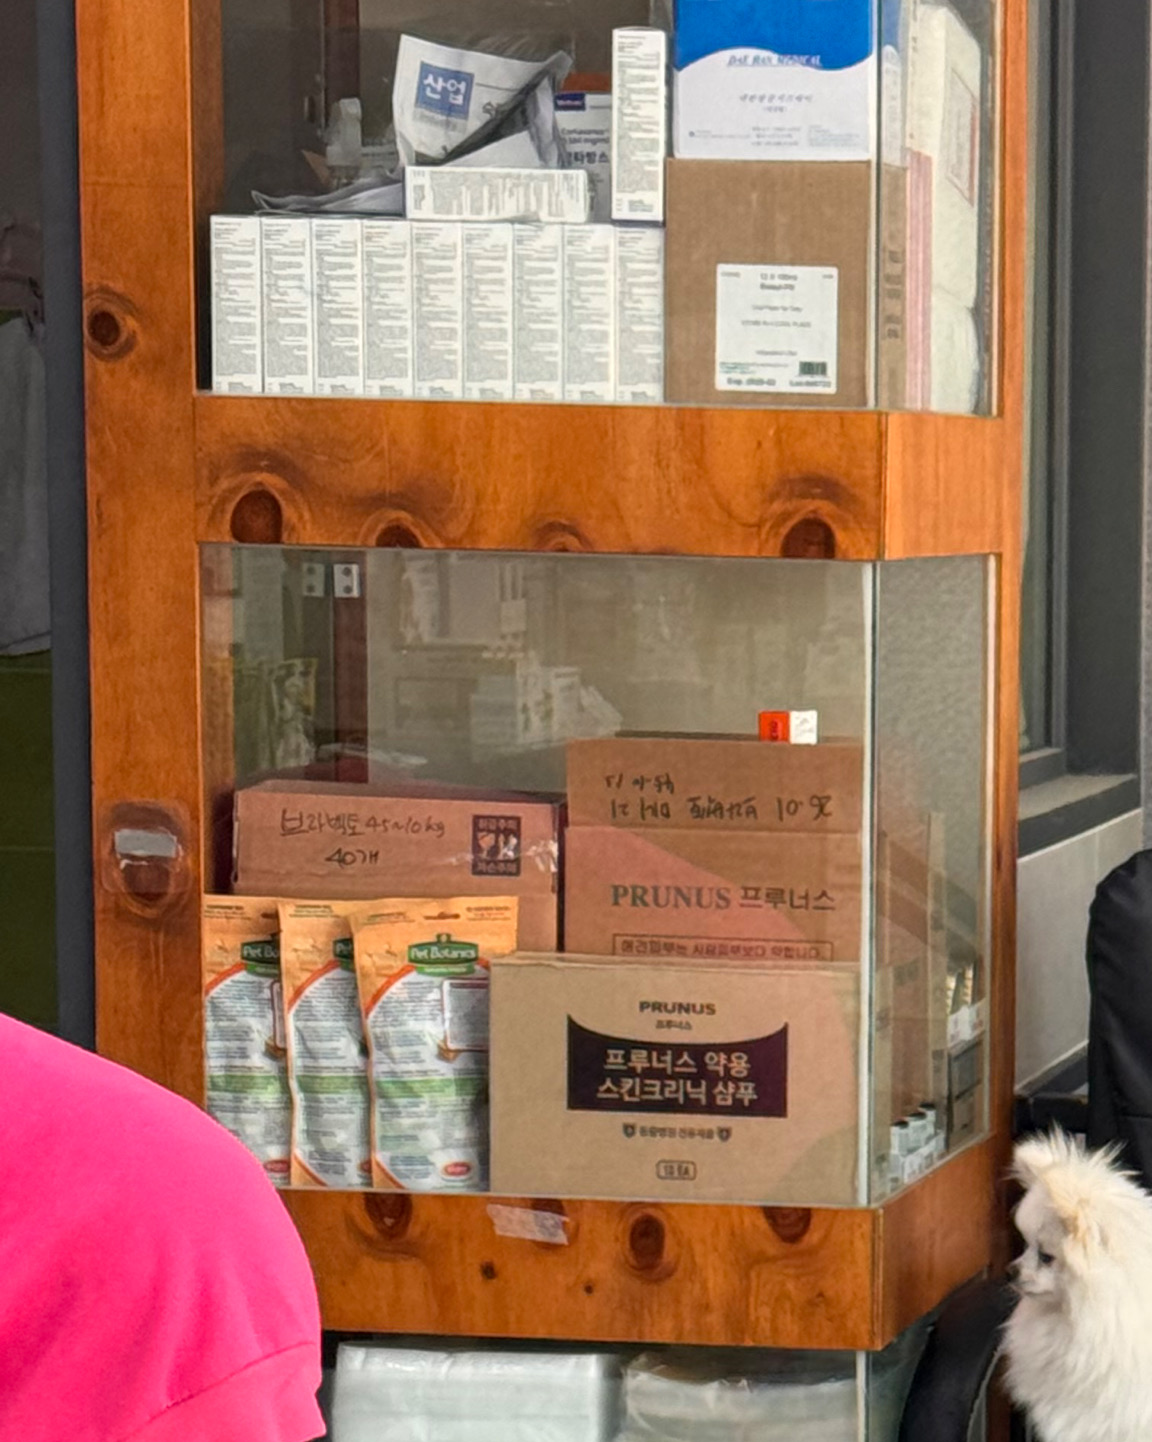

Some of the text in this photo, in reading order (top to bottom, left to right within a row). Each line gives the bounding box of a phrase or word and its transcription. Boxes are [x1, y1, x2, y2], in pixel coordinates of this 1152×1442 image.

[423, 73, 467, 106] 산업
[280, 808, 365, 837] 브라벡토
[324, 847, 380, 869] 40개
[611, 884, 836, 911] PRUNUS 프루너스
[411, 946, 429, 960] Pet
[639, 1001, 717, 1016] PRUNUS
[604, 1049, 750, 1079] 프루너스 약용
[597, 1077, 758, 1107] 스킨크리닉 샴푸
